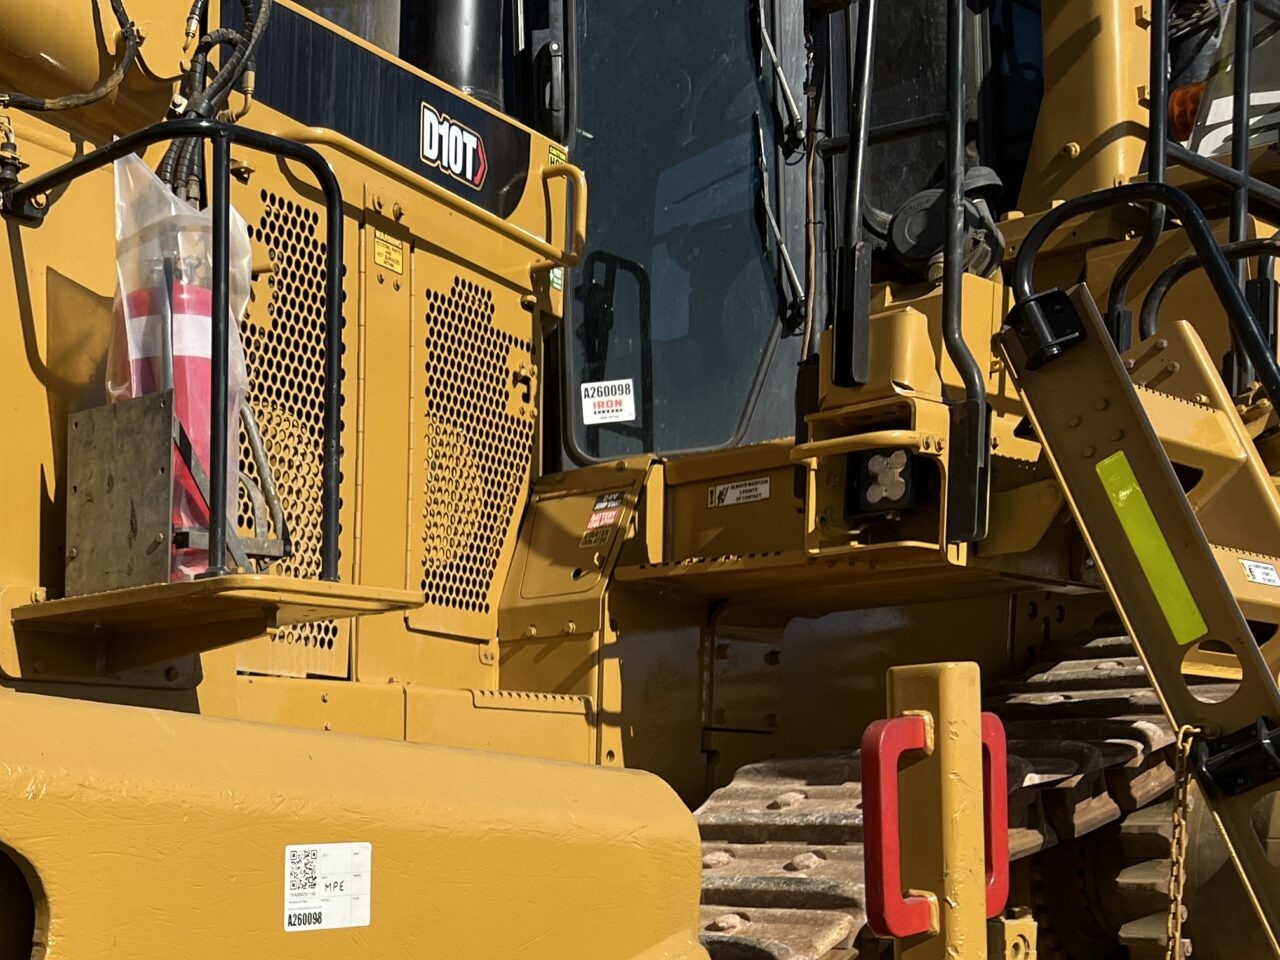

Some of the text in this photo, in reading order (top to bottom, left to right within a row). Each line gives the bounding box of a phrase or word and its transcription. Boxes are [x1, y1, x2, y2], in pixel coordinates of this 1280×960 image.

[423, 107, 477, 181] D10T
[584, 383, 631, 399] A260098
[593, 399, 623, 410] IRON
[603, 492, 619, 501] 24V
[324, 880, 345, 893] MPE
[287, 911, 323, 927] A260098
